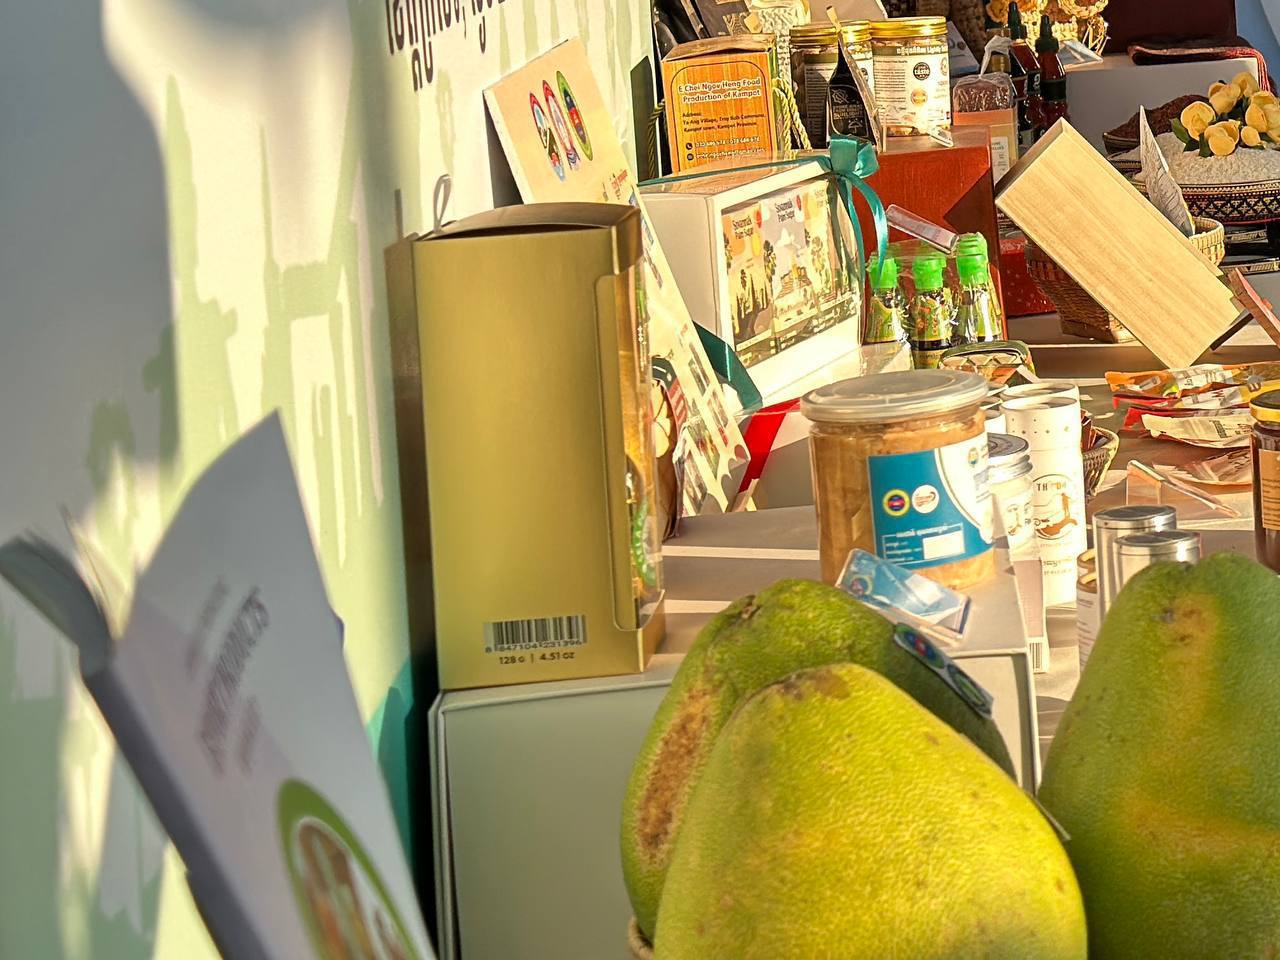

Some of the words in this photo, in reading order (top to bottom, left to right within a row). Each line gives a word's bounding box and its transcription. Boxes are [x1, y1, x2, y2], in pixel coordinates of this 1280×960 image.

[742, 78, 761, 86] Food
[683, 93, 722, 103] Production
[732, 90, 760, 100] Kampot
